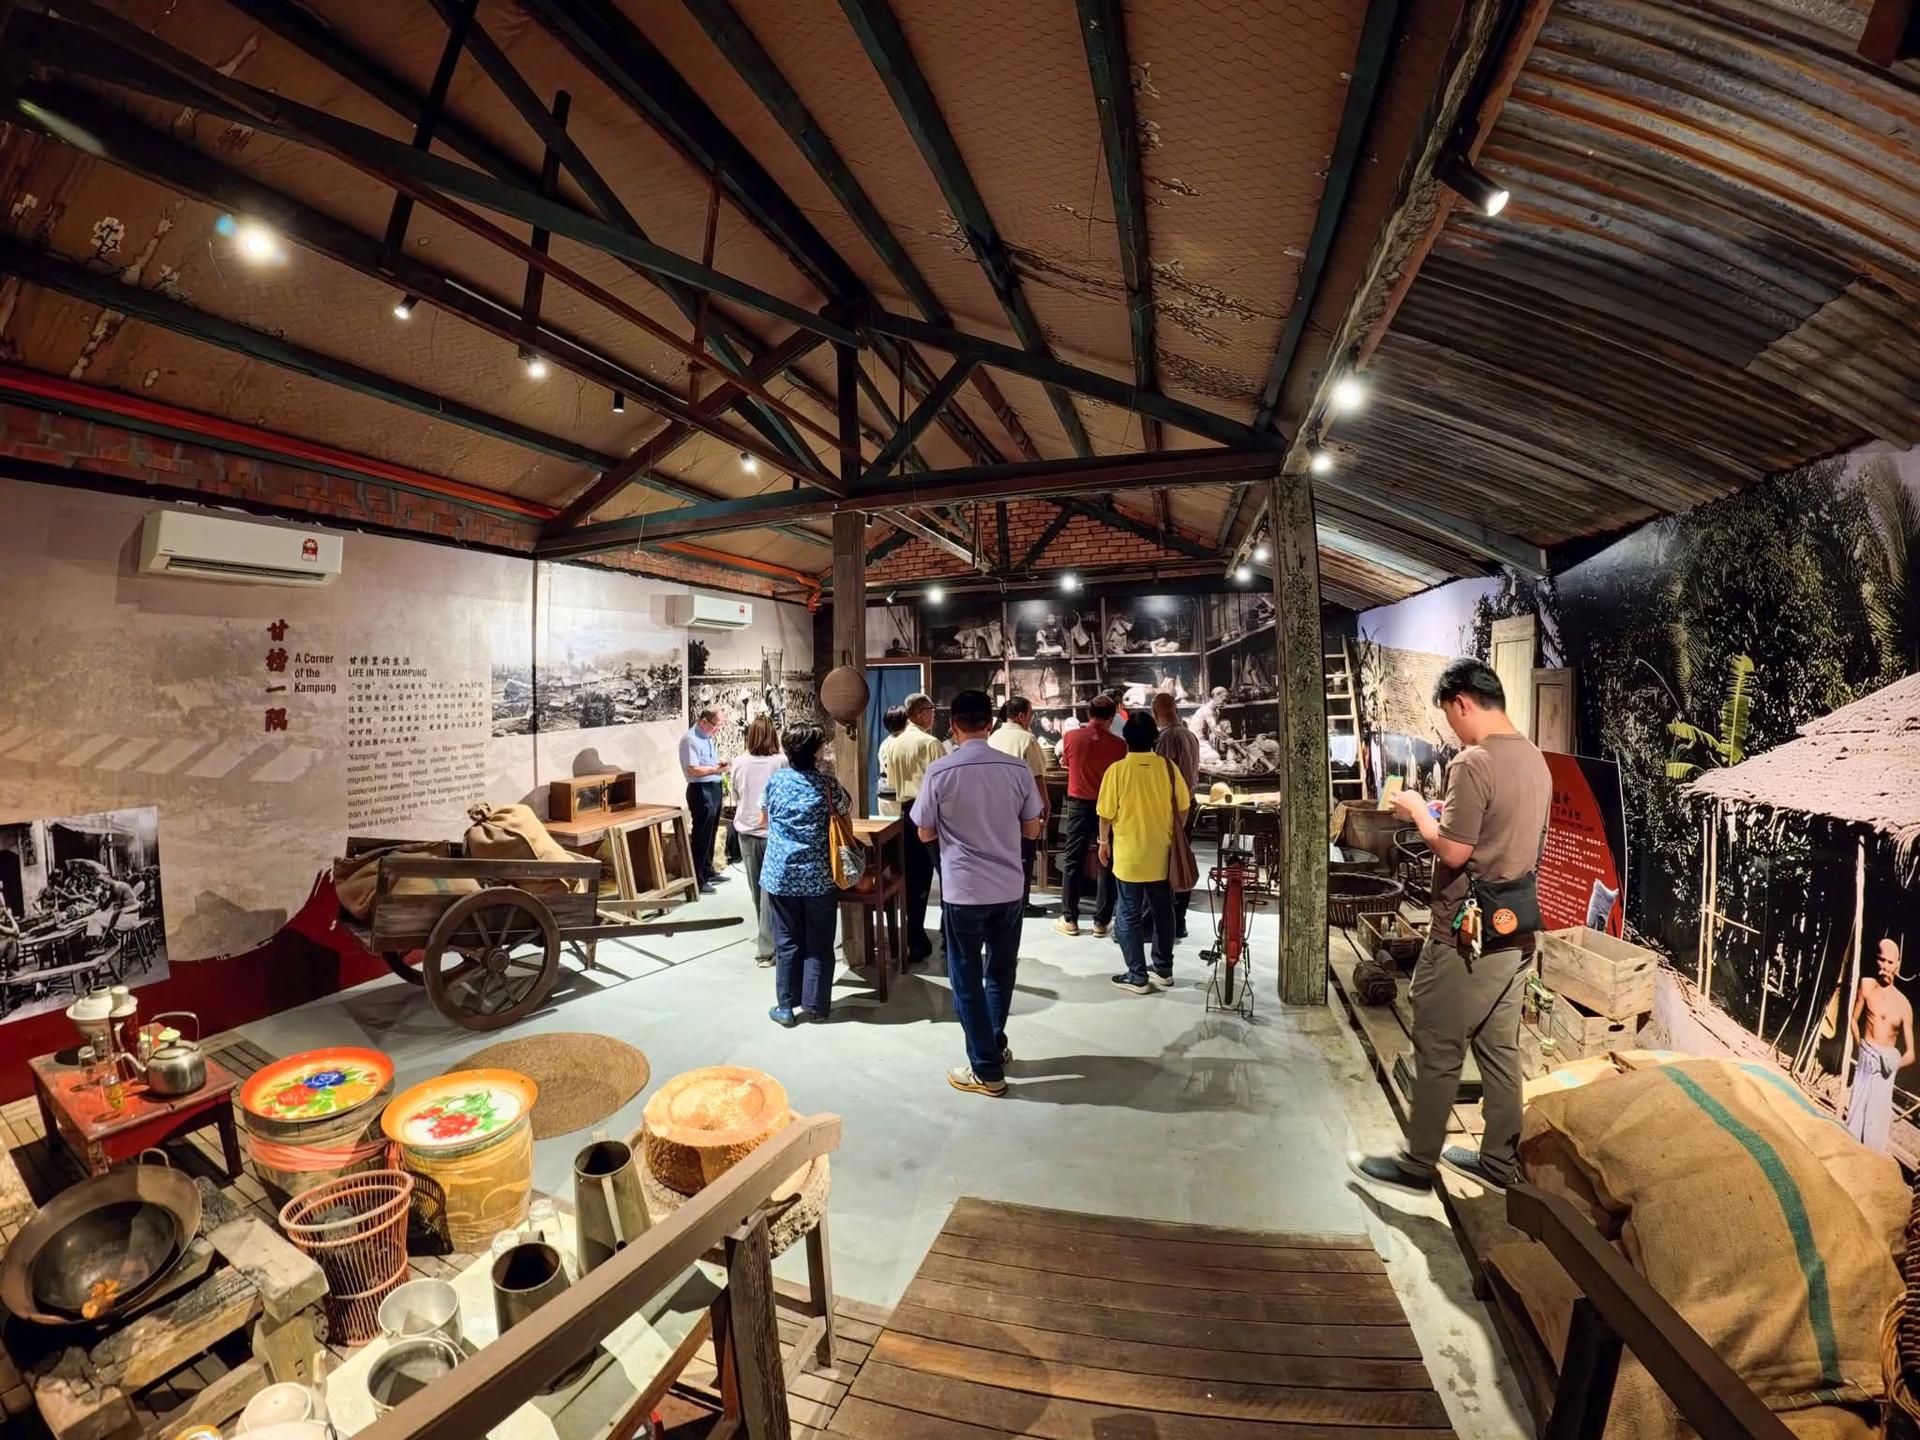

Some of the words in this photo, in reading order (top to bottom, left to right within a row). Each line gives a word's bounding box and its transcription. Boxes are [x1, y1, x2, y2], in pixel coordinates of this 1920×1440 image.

[295, 652, 301, 663] A
[304, 653, 334, 664] Corner
[266, 619, 289, 732] 甘榜一隅
[295, 668, 304, 678] of
[306, 668, 320, 678] the
[348, 669, 364, 677] LIFE
[366, 669, 374, 677] IN
[377, 669, 390, 677] THE
[392, 669, 427, 677] KAMPUNG
[294, 682, 336, 694] Kampung
